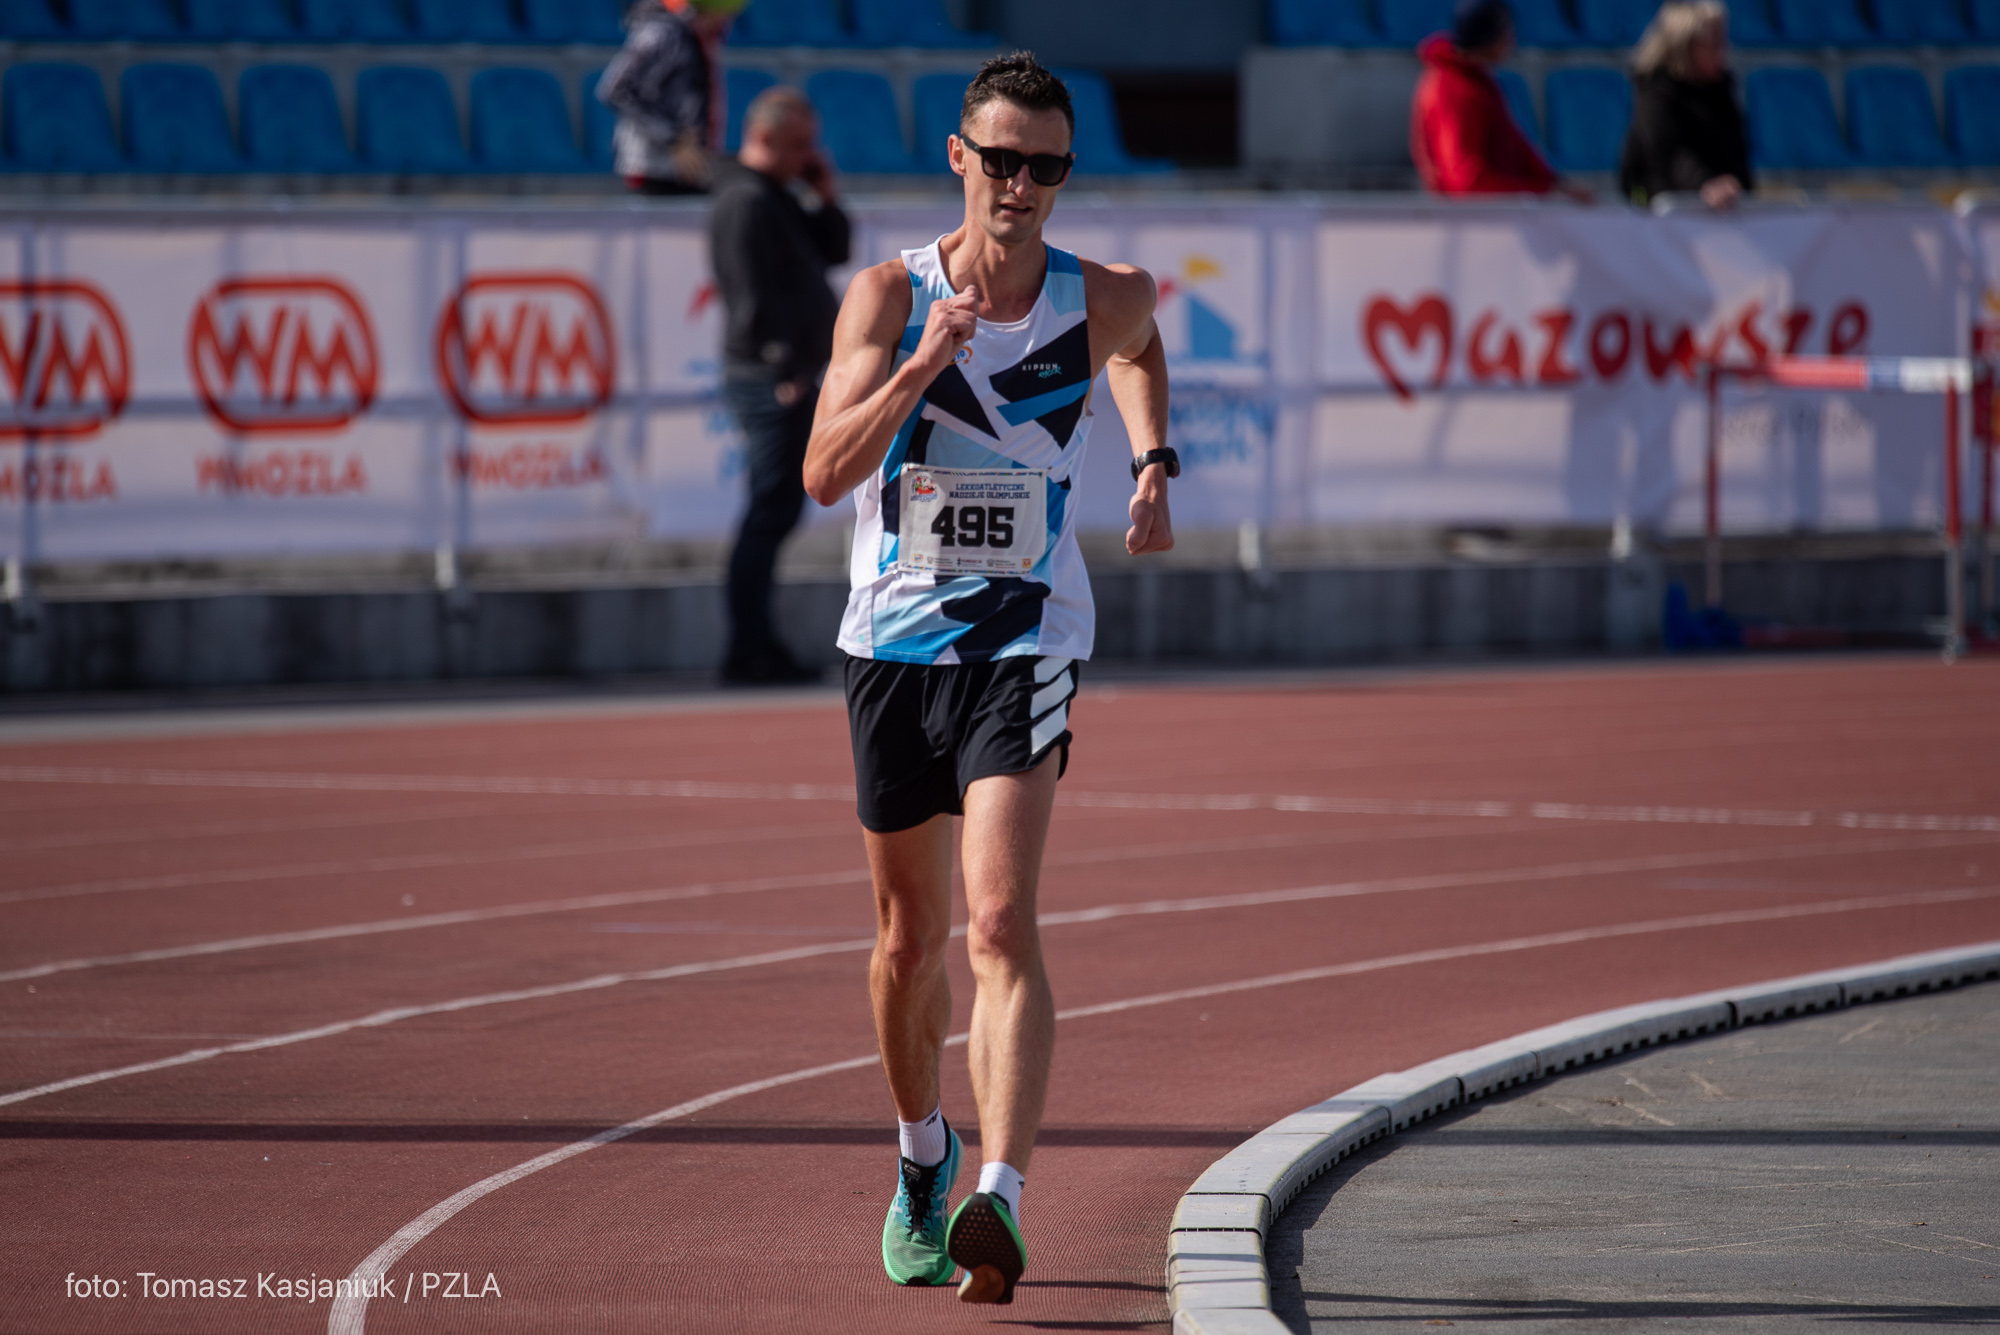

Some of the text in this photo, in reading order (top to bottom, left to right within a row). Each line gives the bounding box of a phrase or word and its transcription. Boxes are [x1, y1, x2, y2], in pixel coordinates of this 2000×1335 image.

[1022, 363, 1058, 371] KIPRUN
[956, 483, 1025, 491] LEKKOATLETYCZNE
[949, 491, 1030, 499] NADZIEJE OLIMPIJSKIE
[931, 506, 1014, 548] 495
